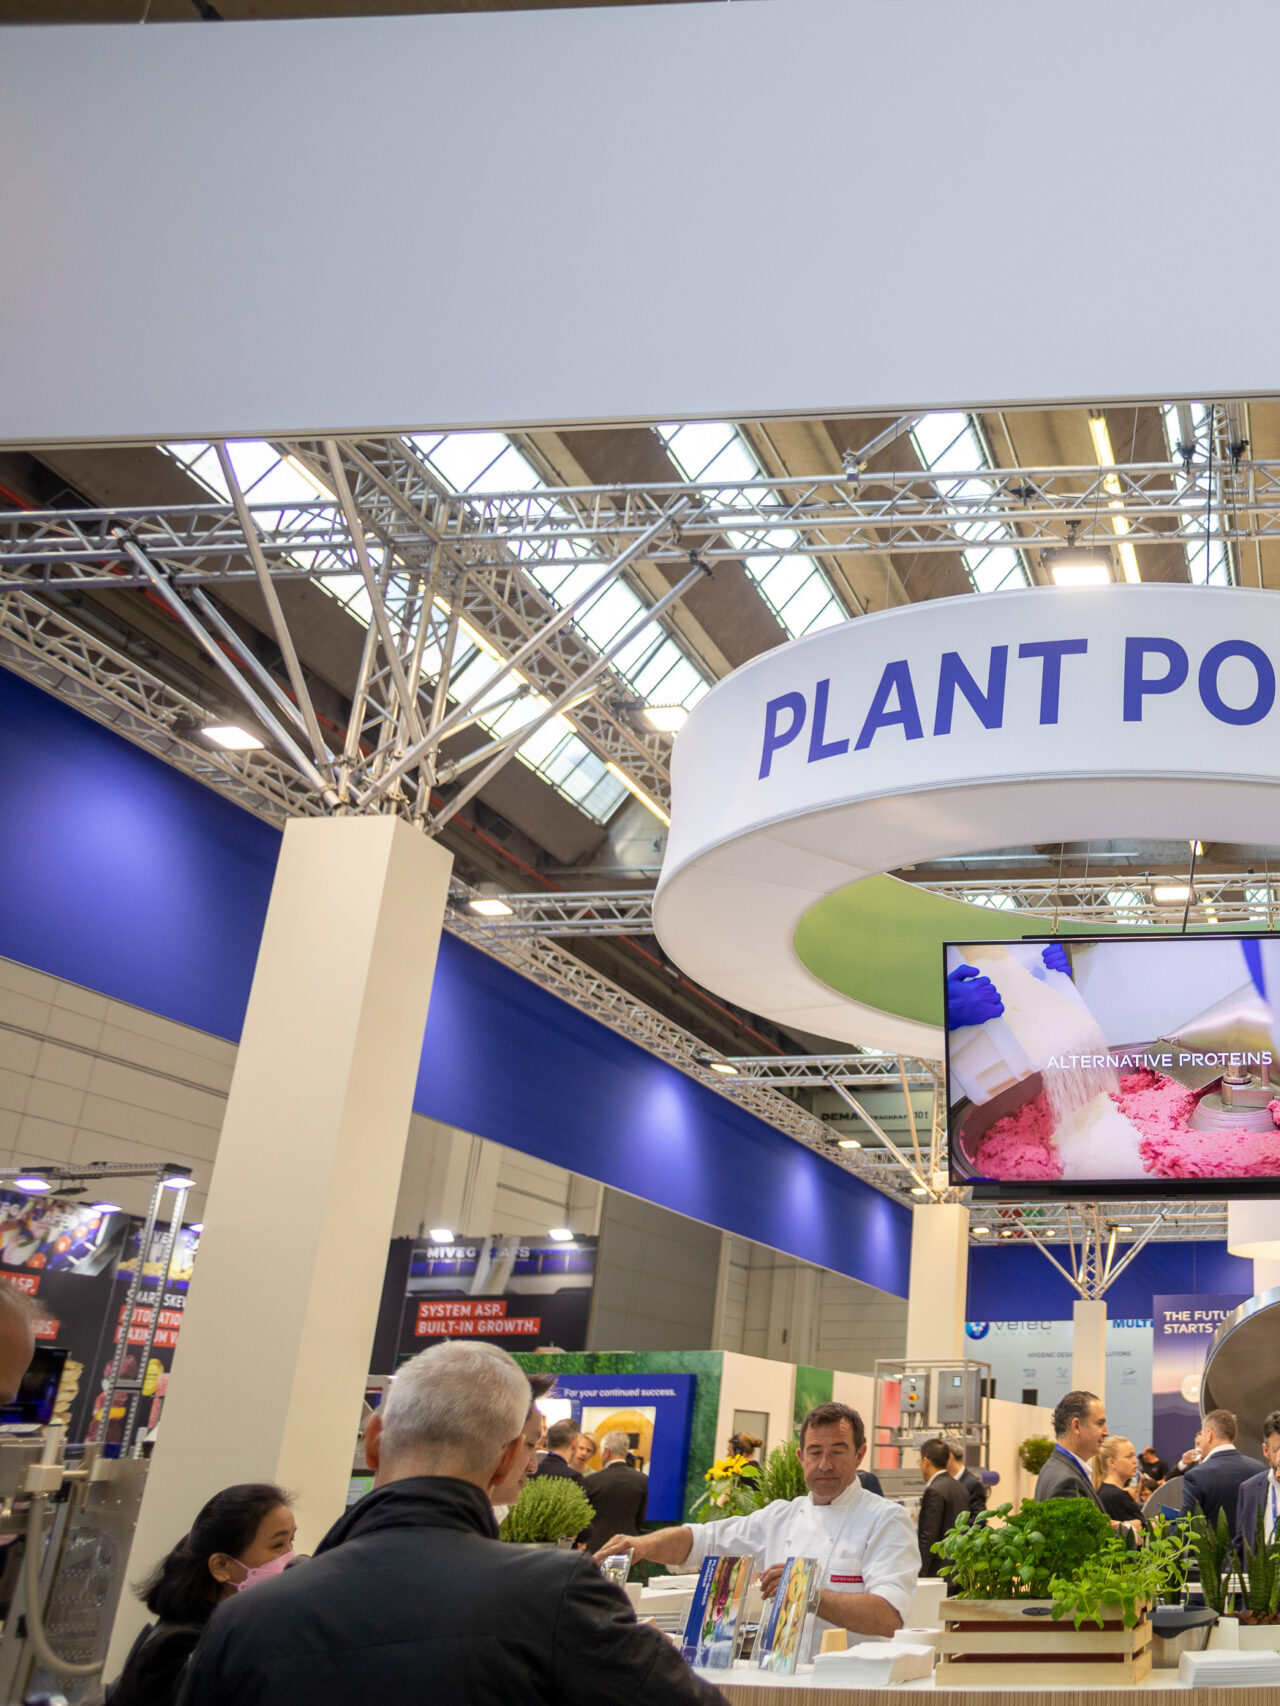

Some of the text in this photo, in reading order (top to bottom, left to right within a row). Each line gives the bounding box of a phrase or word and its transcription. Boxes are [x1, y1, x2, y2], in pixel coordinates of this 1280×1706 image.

[758, 638, 1088, 781] PLANT
[1047, 1051, 1273, 1069] ALTERNATIVE PROTEINS
[821, 1113, 861, 1121] DEMA
[420, 1303, 503, 1318] SYSTEM ASP.
[1163, 1310, 1231, 1321] THE FUTU
[418, 1319, 538, 1334] BUILT-IN GROWTH.
[1163, 1323, 1214, 1334] STARTS
[564, 1387, 677, 1399] For your continued success.
